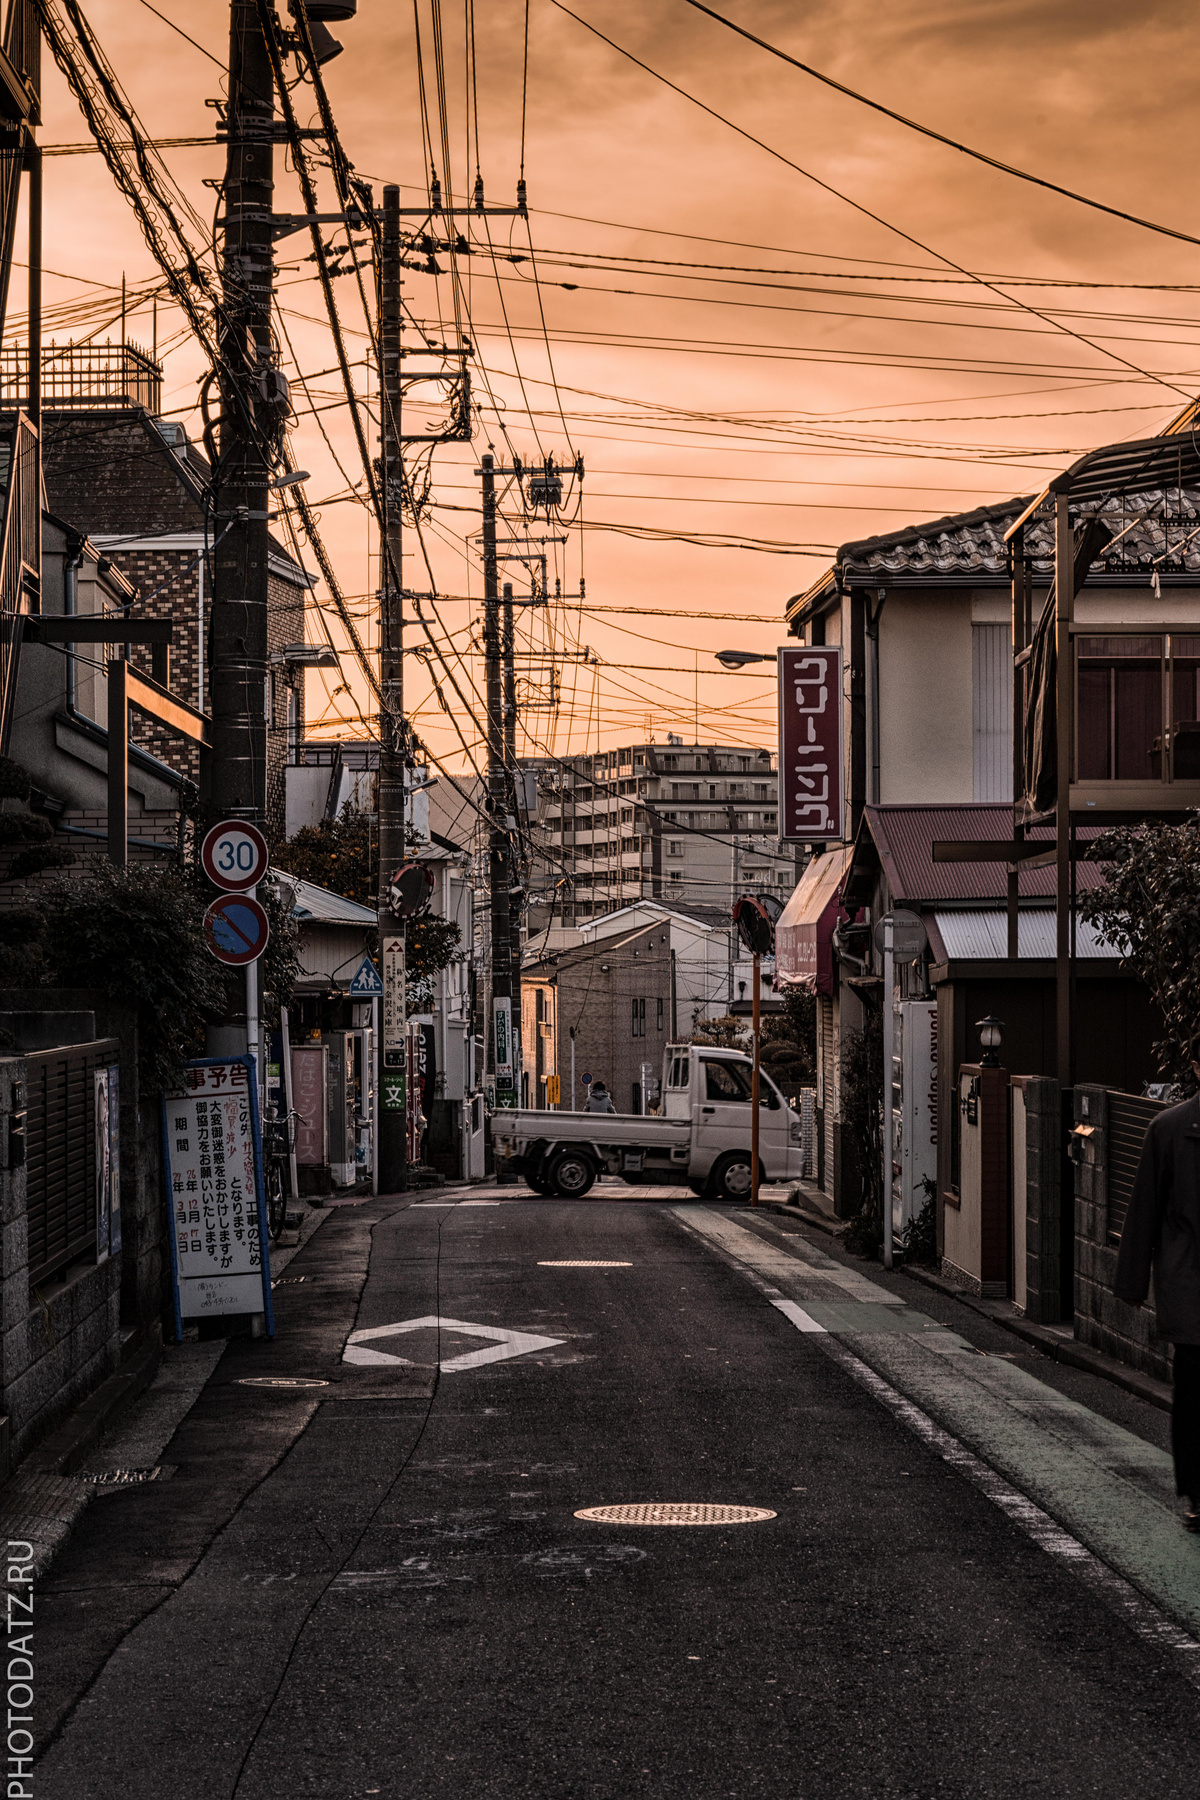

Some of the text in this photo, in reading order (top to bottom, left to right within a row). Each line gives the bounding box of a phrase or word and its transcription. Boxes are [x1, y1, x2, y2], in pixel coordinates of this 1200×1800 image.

[218, 841, 253, 870] 30
[385, 1085, 402, 1103] 文
[195, 1102, 219, 1262] 御協力をお願いいたします。
[209, 1101, 233, 1269] 大変御迷惑をおかけしますが
[230, 1177, 247, 1246] となります。
